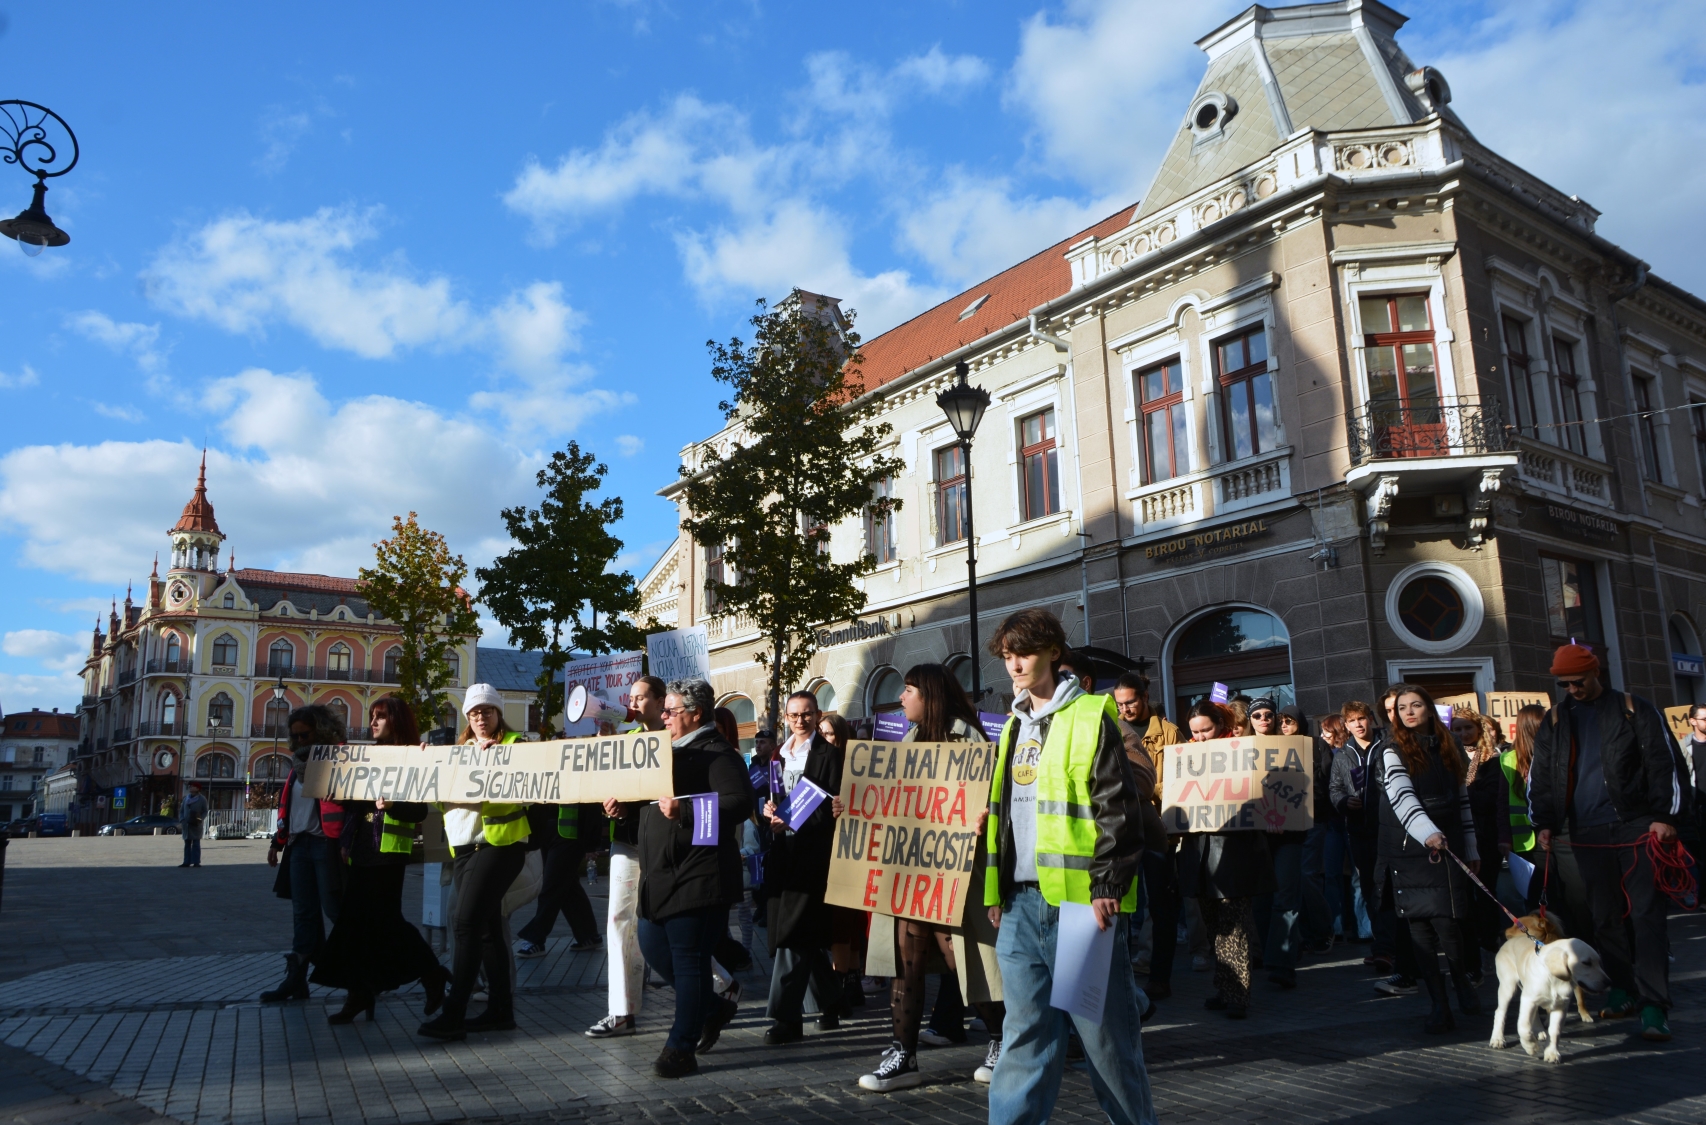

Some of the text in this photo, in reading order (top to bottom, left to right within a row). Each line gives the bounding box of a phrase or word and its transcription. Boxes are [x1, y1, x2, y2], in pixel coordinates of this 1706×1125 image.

[1549, 506, 1576, 522] BIROU
[1580, 514, 1619, 534] NOTARIAL
[1145, 520, 1268, 559] BIROU NOTARIAL
[605, 673, 622, 688] YOUR
[448, 745, 512, 766] PENTRU
[560, 736, 662, 772] FEMEILOR
[850, 742, 993, 782] CEA MAI MICĂ
[1174, 740, 1305, 778] IUBIREA
[1018, 770, 1034, 778] CAFE
[1176, 777, 1250, 802] NU
[848, 780, 967, 827] LOVITURĂ
[1174, 802, 1256, 830] URME
[836, 818, 977, 872] NU E DRAGOSTE
[863, 868, 960, 924] E URĂ!
